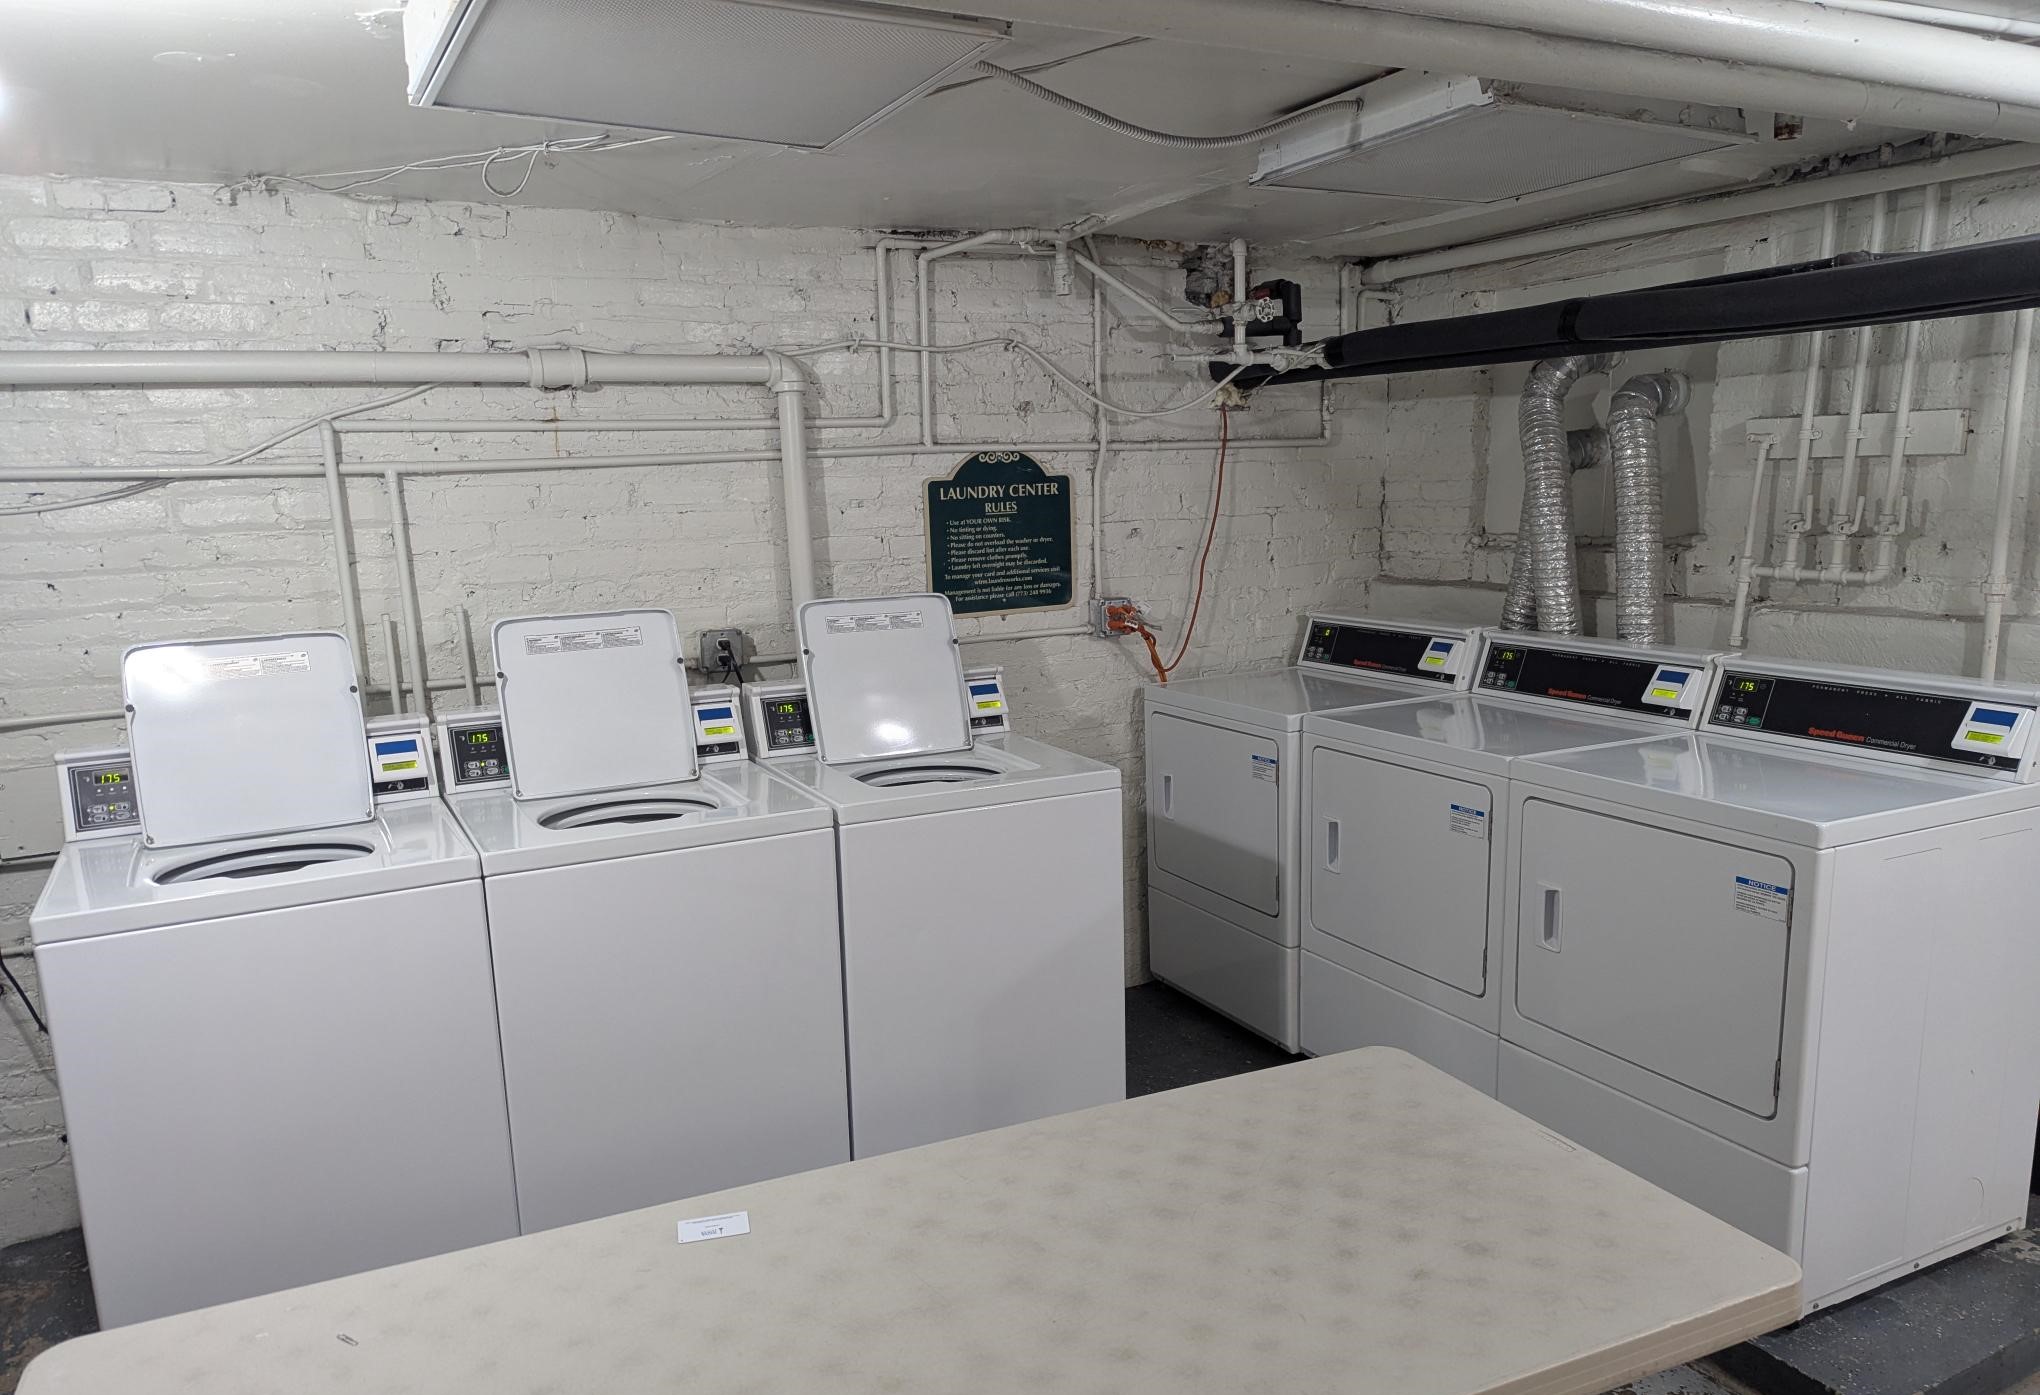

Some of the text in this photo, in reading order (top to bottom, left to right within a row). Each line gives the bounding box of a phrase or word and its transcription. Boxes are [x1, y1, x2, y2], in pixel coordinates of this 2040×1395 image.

[939, 482, 1059, 500] LAUNDRY CENTER
[985, 501, 1018, 512] RULES
[959, 533, 975, 541] sitting
[945, 588, 976, 596] Management
[990, 592, 1004, 600] please
[1740, 681, 1755, 691] 175
[780, 704, 794, 713] 175
[472, 733, 488, 743] 175
[1807, 727, 1917, 751] Speed Queen Commercial Dryer
[101, 773, 121, 785] 175
[1748, 880, 1777, 892] NOTICE
